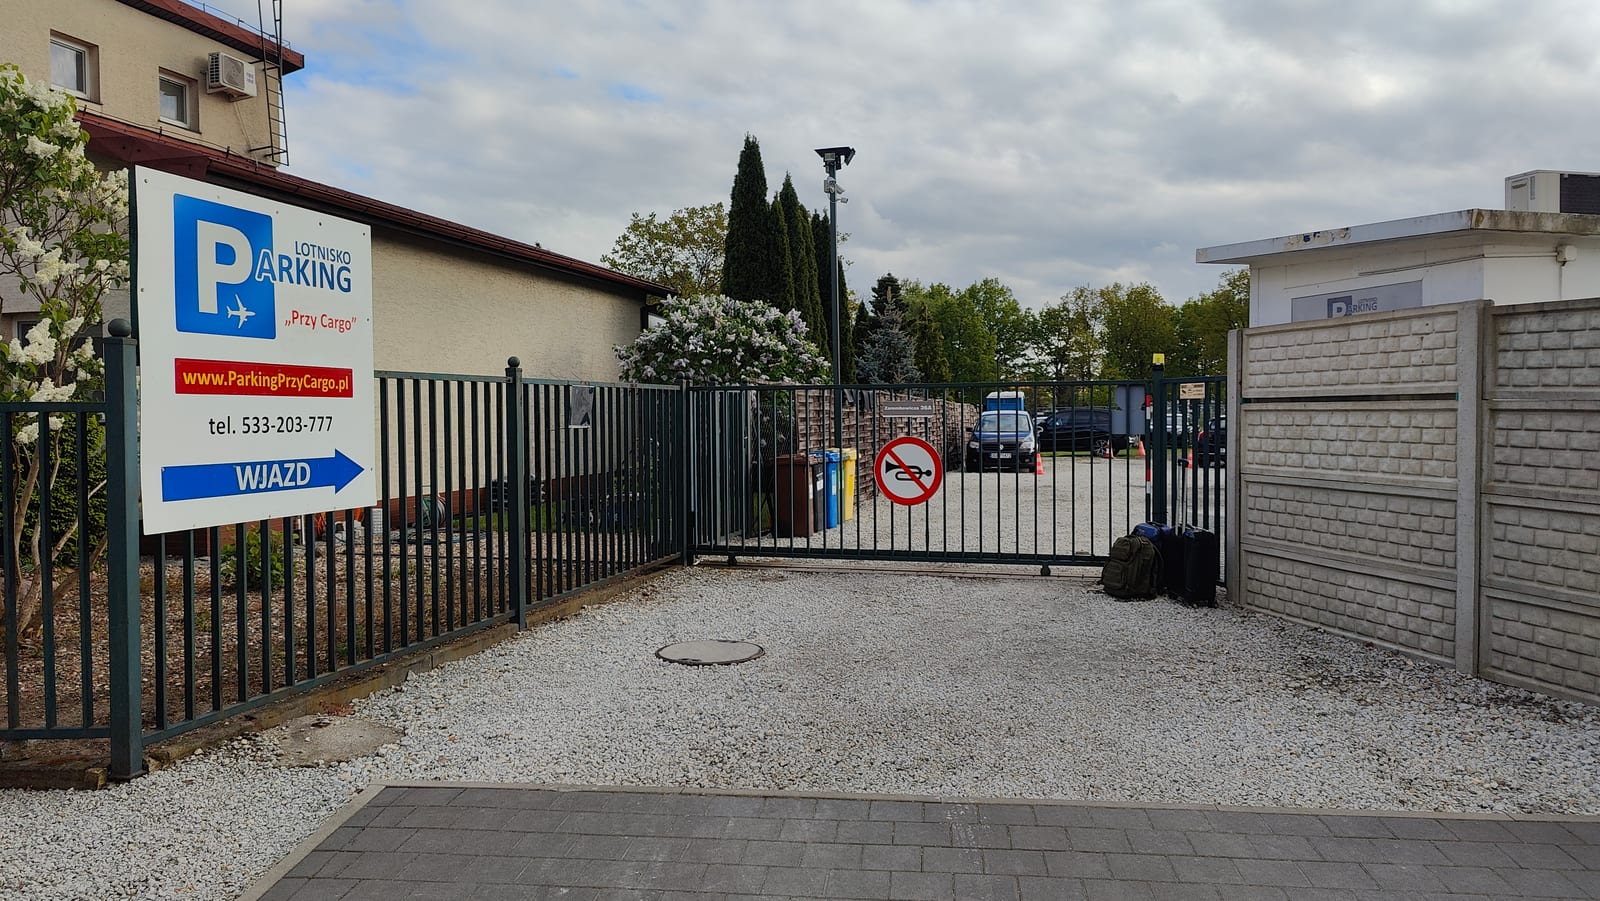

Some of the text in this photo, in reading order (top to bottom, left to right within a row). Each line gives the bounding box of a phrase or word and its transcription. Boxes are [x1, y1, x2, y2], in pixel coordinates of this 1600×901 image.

[295, 241, 351, 265] LOTNISKO
[197, 220, 351, 314] PARKING
[183, 371, 349, 392] www.ParkingPrzyCargo.pl
[208, 416, 333, 435] tel. 533-203-777
[235, 462, 311, 491] WJAZD
